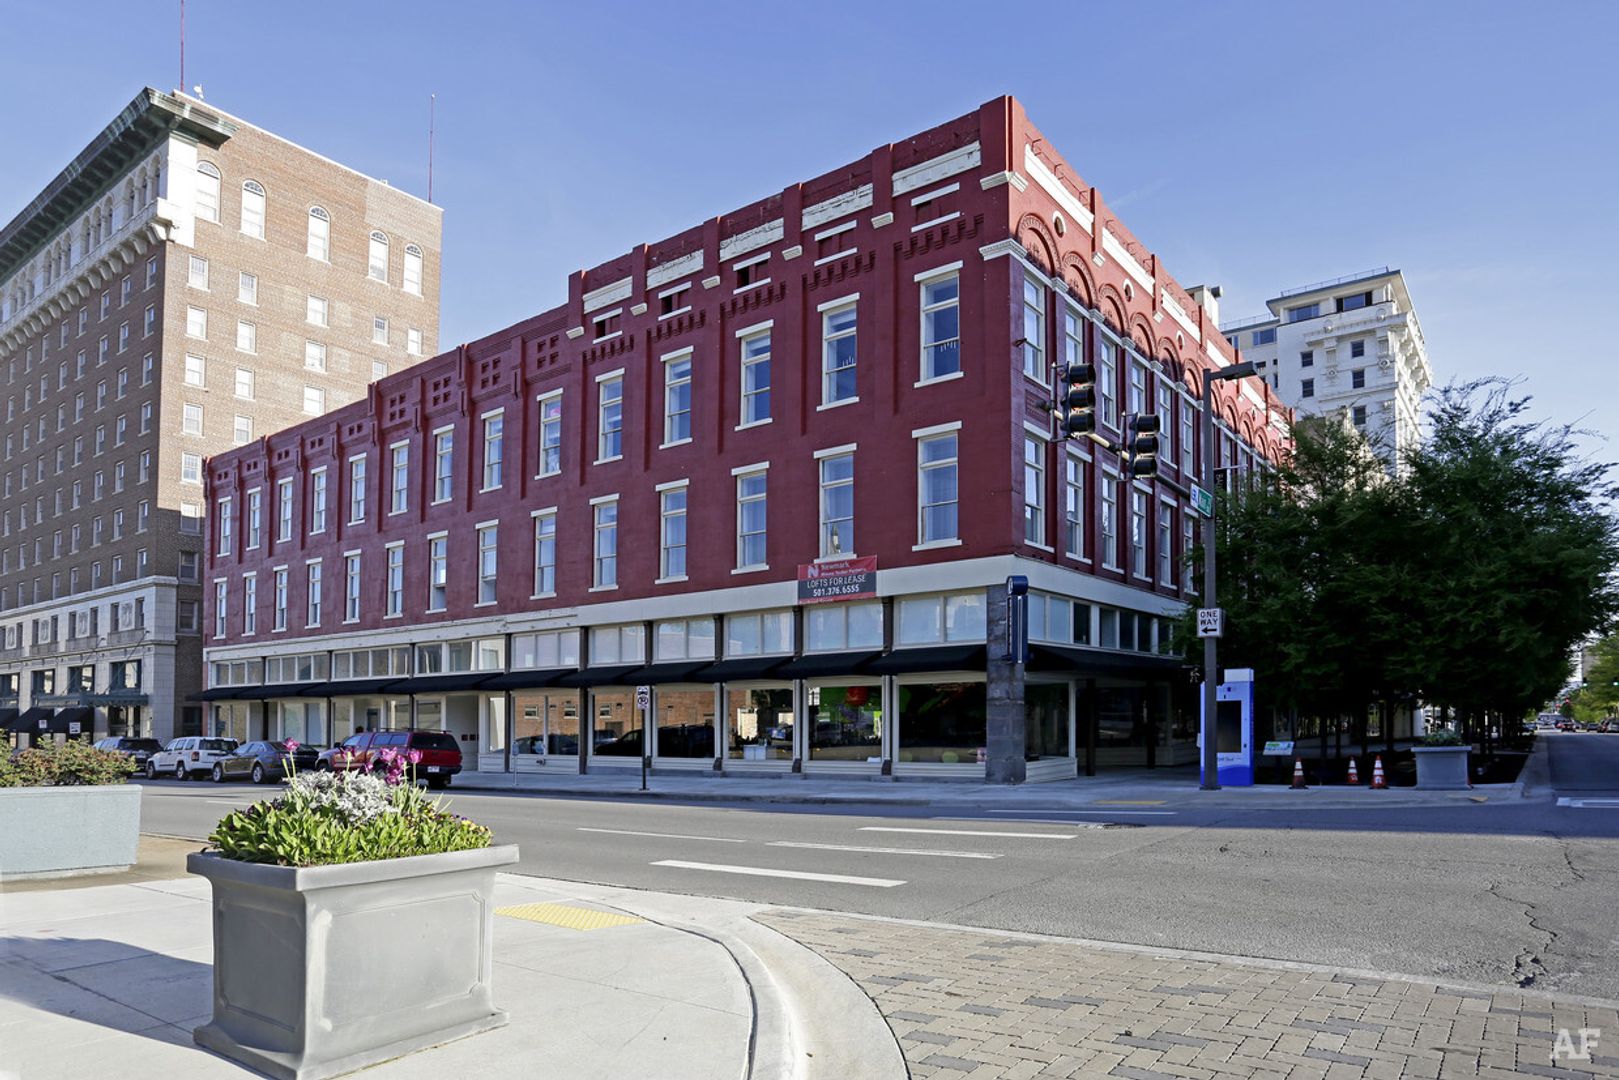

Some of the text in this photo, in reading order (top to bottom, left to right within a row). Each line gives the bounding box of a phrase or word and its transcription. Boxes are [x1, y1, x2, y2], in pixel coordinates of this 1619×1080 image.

[807, 574, 866, 588] LOFTS FOR LEASE
[1200, 610, 1218, 618] ONE
[1200, 618, 1218, 626] WAY
